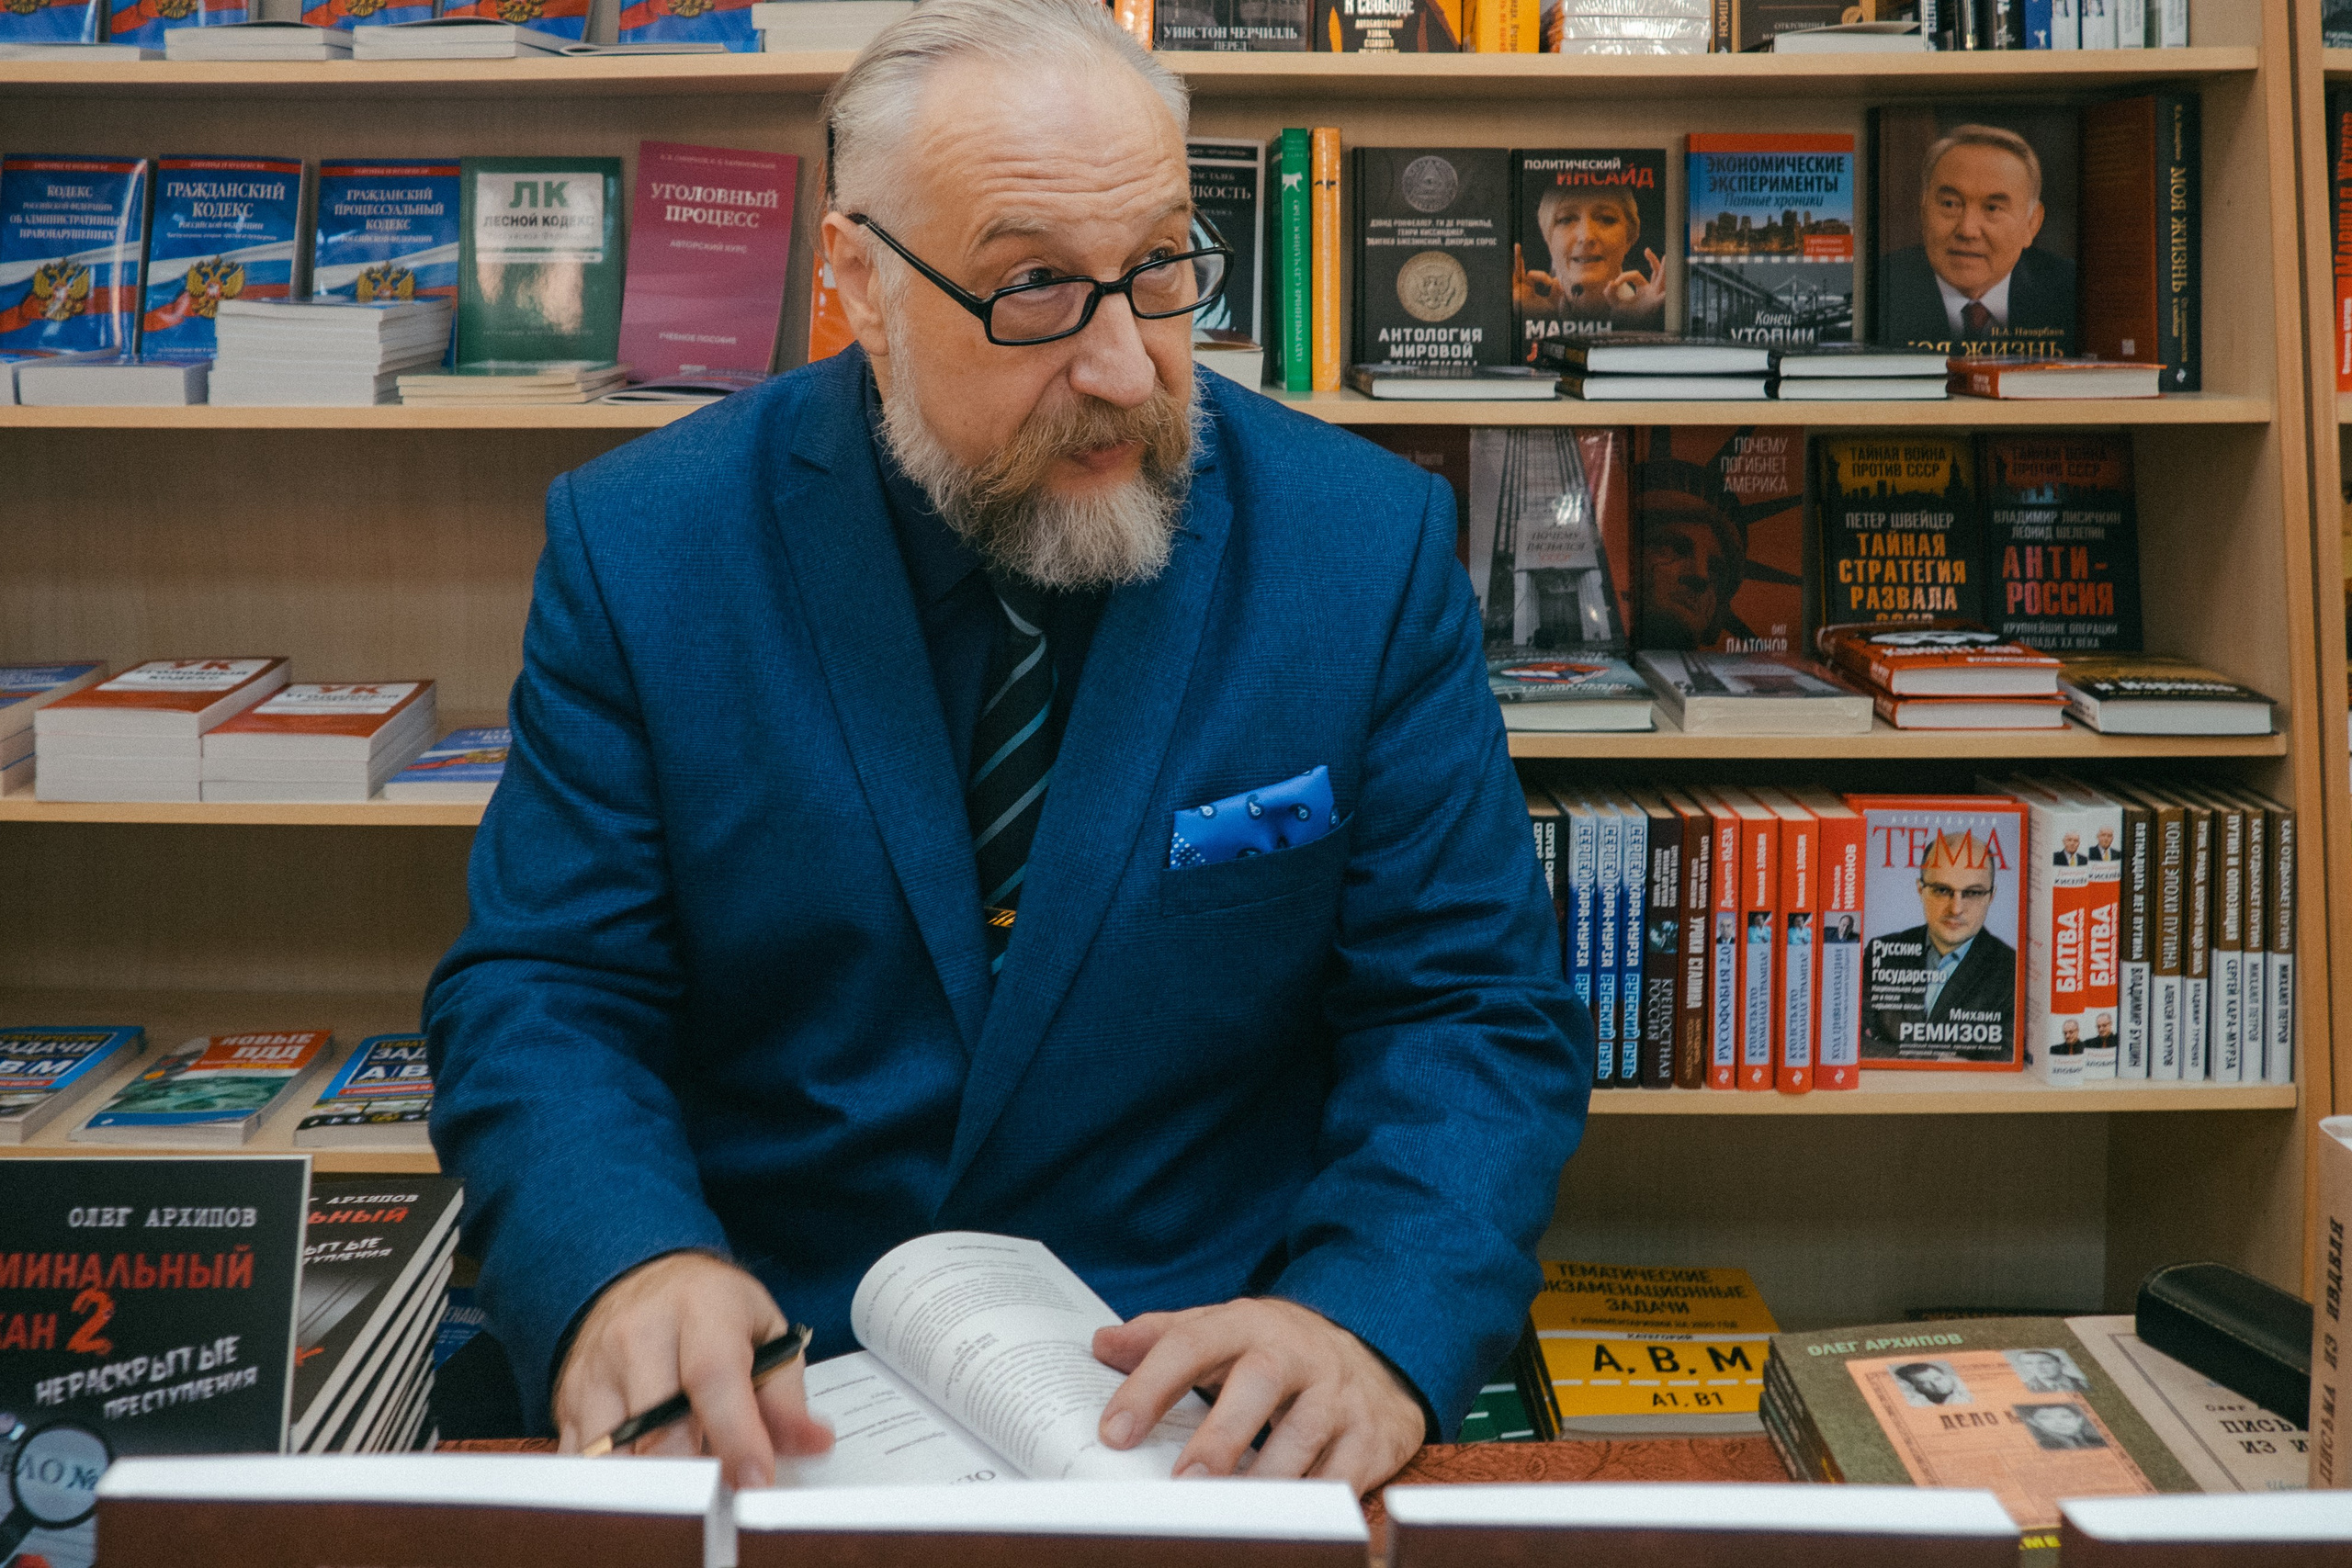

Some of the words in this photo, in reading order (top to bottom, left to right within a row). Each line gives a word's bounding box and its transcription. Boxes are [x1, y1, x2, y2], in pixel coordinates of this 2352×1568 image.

[1163, 26, 1227, 39] УИНСТОН
[1229, 27, 1298, 39] ЧЕРЧИЛЛЬ
[1523, 157, 1622, 170] ПОЛИТИЧЕСКИЙ
[1556, 163, 1655, 189] ИНСАЙД
[1706, 155, 1845, 174] ЭКОНОМИЧЕСКИЕ
[47, 186, 93, 198] КОДЕКС
[166, 182, 286, 200] ГРАЖДАНСКИЙ
[346, 186, 433, 200] ГРАЖДАНСКИЙ
[509, 181, 570, 209] ЛК
[650, 183, 778, 209] УГОЛОВНЫЙ
[1708, 175, 1838, 193] ЭКСПЕРИМЕНТЫ
[2170, 166, 2187, 212] МОЯ
[192, 202, 254, 220] КОДЕКС
[334, 202, 445, 216] ПРОЦЕССУАЛЬНЫЙ
[483, 213, 537, 227] ЛЕСНОЙ
[542, 215, 595, 229] КОДЕКС
[664, 205, 760, 228] ПРОЦЕСС
[366, 219, 412, 231] КОДЕКС
[2170, 217, 2188, 293] ЖИЗНЬ
[1755, 310, 1792, 326] Конец
[1378, 328, 1483, 343] АНТОЛОГИЯ
[1390, 342, 1474, 358] МИРОВОЙ
[1962, 341, 2064, 358] ЖИЗНЬ
[1735, 436, 1789, 454] ПОЧЕМУ
[1849, 445, 1900, 461] ТАЙНАЯ
[1904, 445, 1946, 461] ВОЙНА
[1721, 457, 1788, 474] ПОГИБНЕТ
[1852, 463, 1902, 478] ПРОТИВ
[1906, 463, 1940, 478] СССР
[1724, 476, 1789, 493] АМЕРИКА
[1845, 512, 1886, 529] ПЕТЕР
[1890, 510, 1954, 530] ШВЕЙЦЕР
[1994, 510, 2058, 525] ВЛАДИМИР
[2011, 525, 2052, 540] ЛЕОНИД
[1856, 530, 1946, 557] ТАЙНАЯ
[1838, 558, 1967, 584] СТРАТЕГИЯ
[2002, 546, 2108, 580] АНТИ-
[1850, 585, 1958, 611] РАЗВАЛА
[2006, 581, 2114, 615] РОССИЯ
[1726, 637, 1788, 653] ПЛАТОНОВ
[1545, 822, 1556, 859] СЕРГЕЙ
[1722, 828, 1734, 862] КЬЕЗА
[2162, 821, 2181, 865] КОНЕЦ
[2226, 815, 2240, 854] ПУТИН
[2251, 818, 2261, 845] КАК
[2280, 819, 2291, 846] КАК
[1577, 825, 1593, 880] СЕРГЕЙ
[1601, 825, 1617, 880] СЕРГЕЙ
[1627, 825, 1645, 880] СЕРГЕЙ
[1871, 826, 2012, 871] ТЕМА
[2132, 822, 2147, 891] ПЯТНАДЦАТЬ
[1844, 843, 1857, 909] НИКОНОВ
[2162, 868, 2179, 912] ЭПОХИ
[2248, 846, 2260, 908] ОТДЫХАЕТ
[2278, 848, 2291, 908] ОТДЫХАЕТ
[2132, 894, 2144, 913] ЛЕТ
[2223, 868, 2239, 941] ОППОЗИЦИЯ
[1577, 881, 1592, 967] КАРА-МУРЗА
[1600, 881, 1617, 968] КАРА-МУРЗА
[1626, 881, 1645, 967] КАРА-МУРЗА
[1689, 917, 1704, 953] УРОКИ
[2131, 915, 2144, 960] ПУТИНА
[2249, 909, 2260, 947] ПУТИН
[2278, 910, 2290, 950] ПУТИН
[1720, 945, 1731, 965] 2.0
[1871, 939, 1923, 957] Русские
[2055, 909, 2077, 992] БИТВА
[2089, 903, 2111, 987] БИТВА
[2162, 916, 2179, 970] ПУТИНА
[1687, 957, 1703, 1009] СТАЛИНА
[1871, 967, 1948, 985] государство
[2226, 959, 2240, 995] СЕРГЕЙ
[2278, 964, 2289, 1005] МИХАИЛ
[1599, 974, 1615, 1040] РУССКИЙ
[1623, 974, 1641, 1040] РУССКИЙ
[1647, 978, 1661, 1040] РОССИЯ
[2128, 967, 2144, 1026] ВЛАДИМИР
[1658, 978, 1674, 1079] КРЕПОСТНАЯ
[1718, 968, 1731, 1060] РУСОФОБИЯ
[1950, 1008, 2002, 1022] Михаил
[2278, 1007, 2289, 1044] ПЕТРОВ
[220, 1033, 316, 1045] НОВЫЕ
[1899, 1022, 2003, 1043] РЕМИЗОВ
[2128, 1029, 2143, 1067] БУШИН
[2225, 999, 2238, 1069] КАРА-МУРЗА
[232, 1045, 306, 1059] ПДД
[1598, 1042, 1614, 1079] ПУТЬ
[1622, 1041, 1639, 1079] ПУТЬ
[326, 1194, 419, 1204] АРХИПОВ
[68, 1208, 133, 1227] ОЛЕГ
[143, 1208, 257, 1227] АРХИПОВ
[1559, 1263, 1710, 1282] ТЕМАТИЧЕСКИЕ
[2325, 1215, 2344, 1324] ИВДЕЛЯ
[1606, 1298, 1690, 1314] ЗАДАЧИ
[65, 1287, 116, 1357] 2
[1807, 1340, 1860, 1357] ОЛЕГ
[1865, 1333, 1964, 1351] АРХИПОВ
[2323, 1332, 2338, 1370] ИЗ
[35, 1336, 241, 1406] НЕРАСКРЫТЫЕ
[103, 1366, 258, 1421] ПРЕСТУПЛЕНИЯ
[1939, 1411, 1999, 1429] ДЕЛО
[2319, 1383, 2335, 1485] ПИСЬМА
[2239, 1440, 2277, 1454] ИЗ
